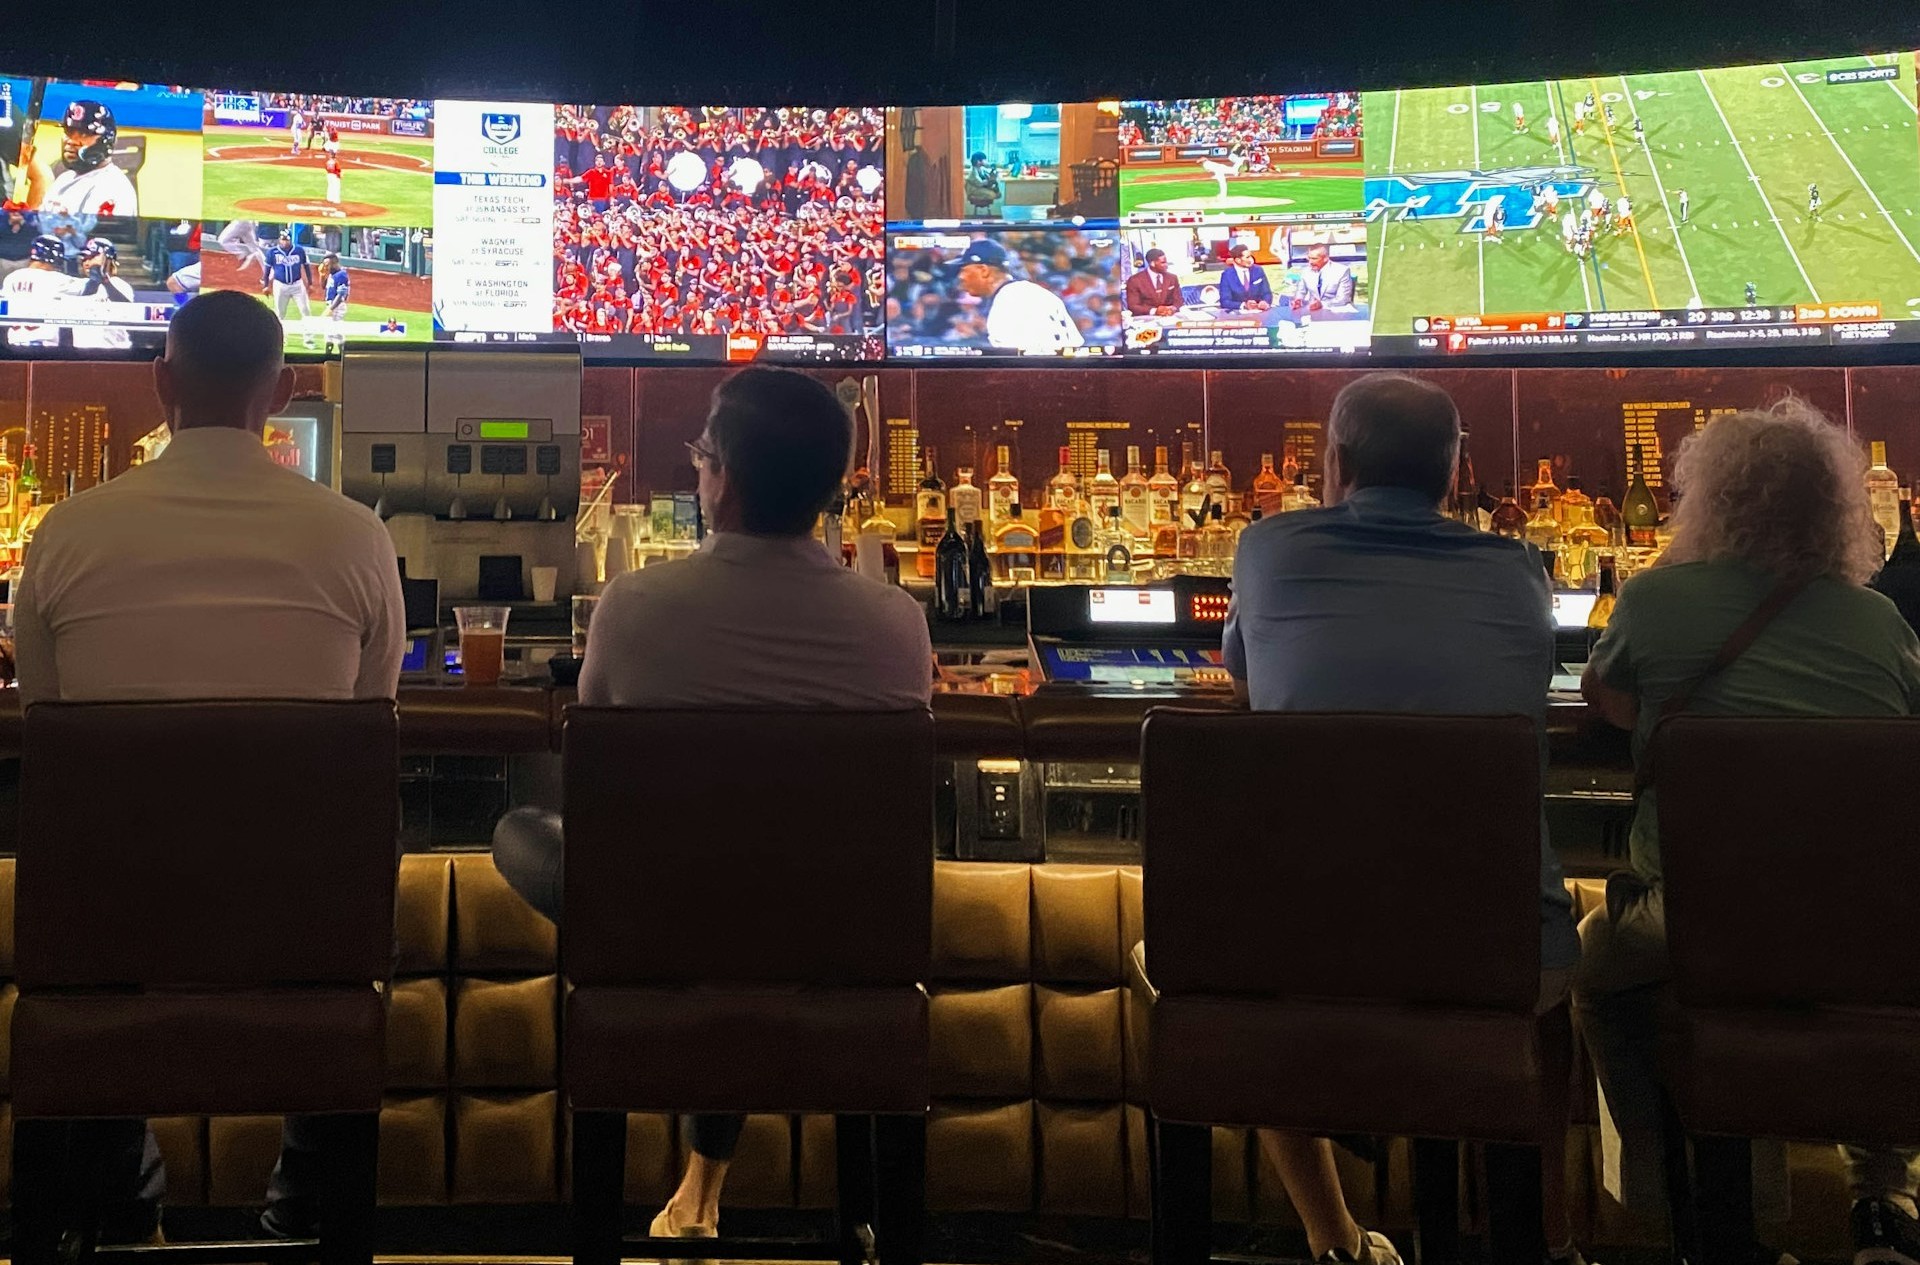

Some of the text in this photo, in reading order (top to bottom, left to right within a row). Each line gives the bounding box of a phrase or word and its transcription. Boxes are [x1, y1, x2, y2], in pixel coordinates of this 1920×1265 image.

[1858, 68, 1897, 79] SPORTS
[324, 120, 380, 130] TRUIST PARK
[483, 146, 519, 155] COLLEGE
[1278, 145, 1312, 153] STADIUM
[487, 174, 543, 187] WEEKEND
[474, 195, 524, 205] TEXAS TECH
[484, 205, 519, 214] KANSAS
[481, 238, 516, 246] WAGNER
[481, 247, 524, 255] SYRACUSE
[474, 280, 529, 288] WASHINGTON
[485, 289, 520, 297] FLORIDA
[1455, 317, 1482, 326] UTSA
[1589, 313, 1630, 322] MIDDLE
[1630, 312, 1661, 320] TENN
[1687, 312, 1706, 323] 20
[1711, 312, 1735, 322] 3RD
[1799, 308, 1826, 319] 2ND
[1828, 305, 1878, 318] DOWN
[1860, 322, 1896, 331] SPORTS
[586, 333, 611, 342] Braves
[1841, 331, 1890, 340] NETWORK
